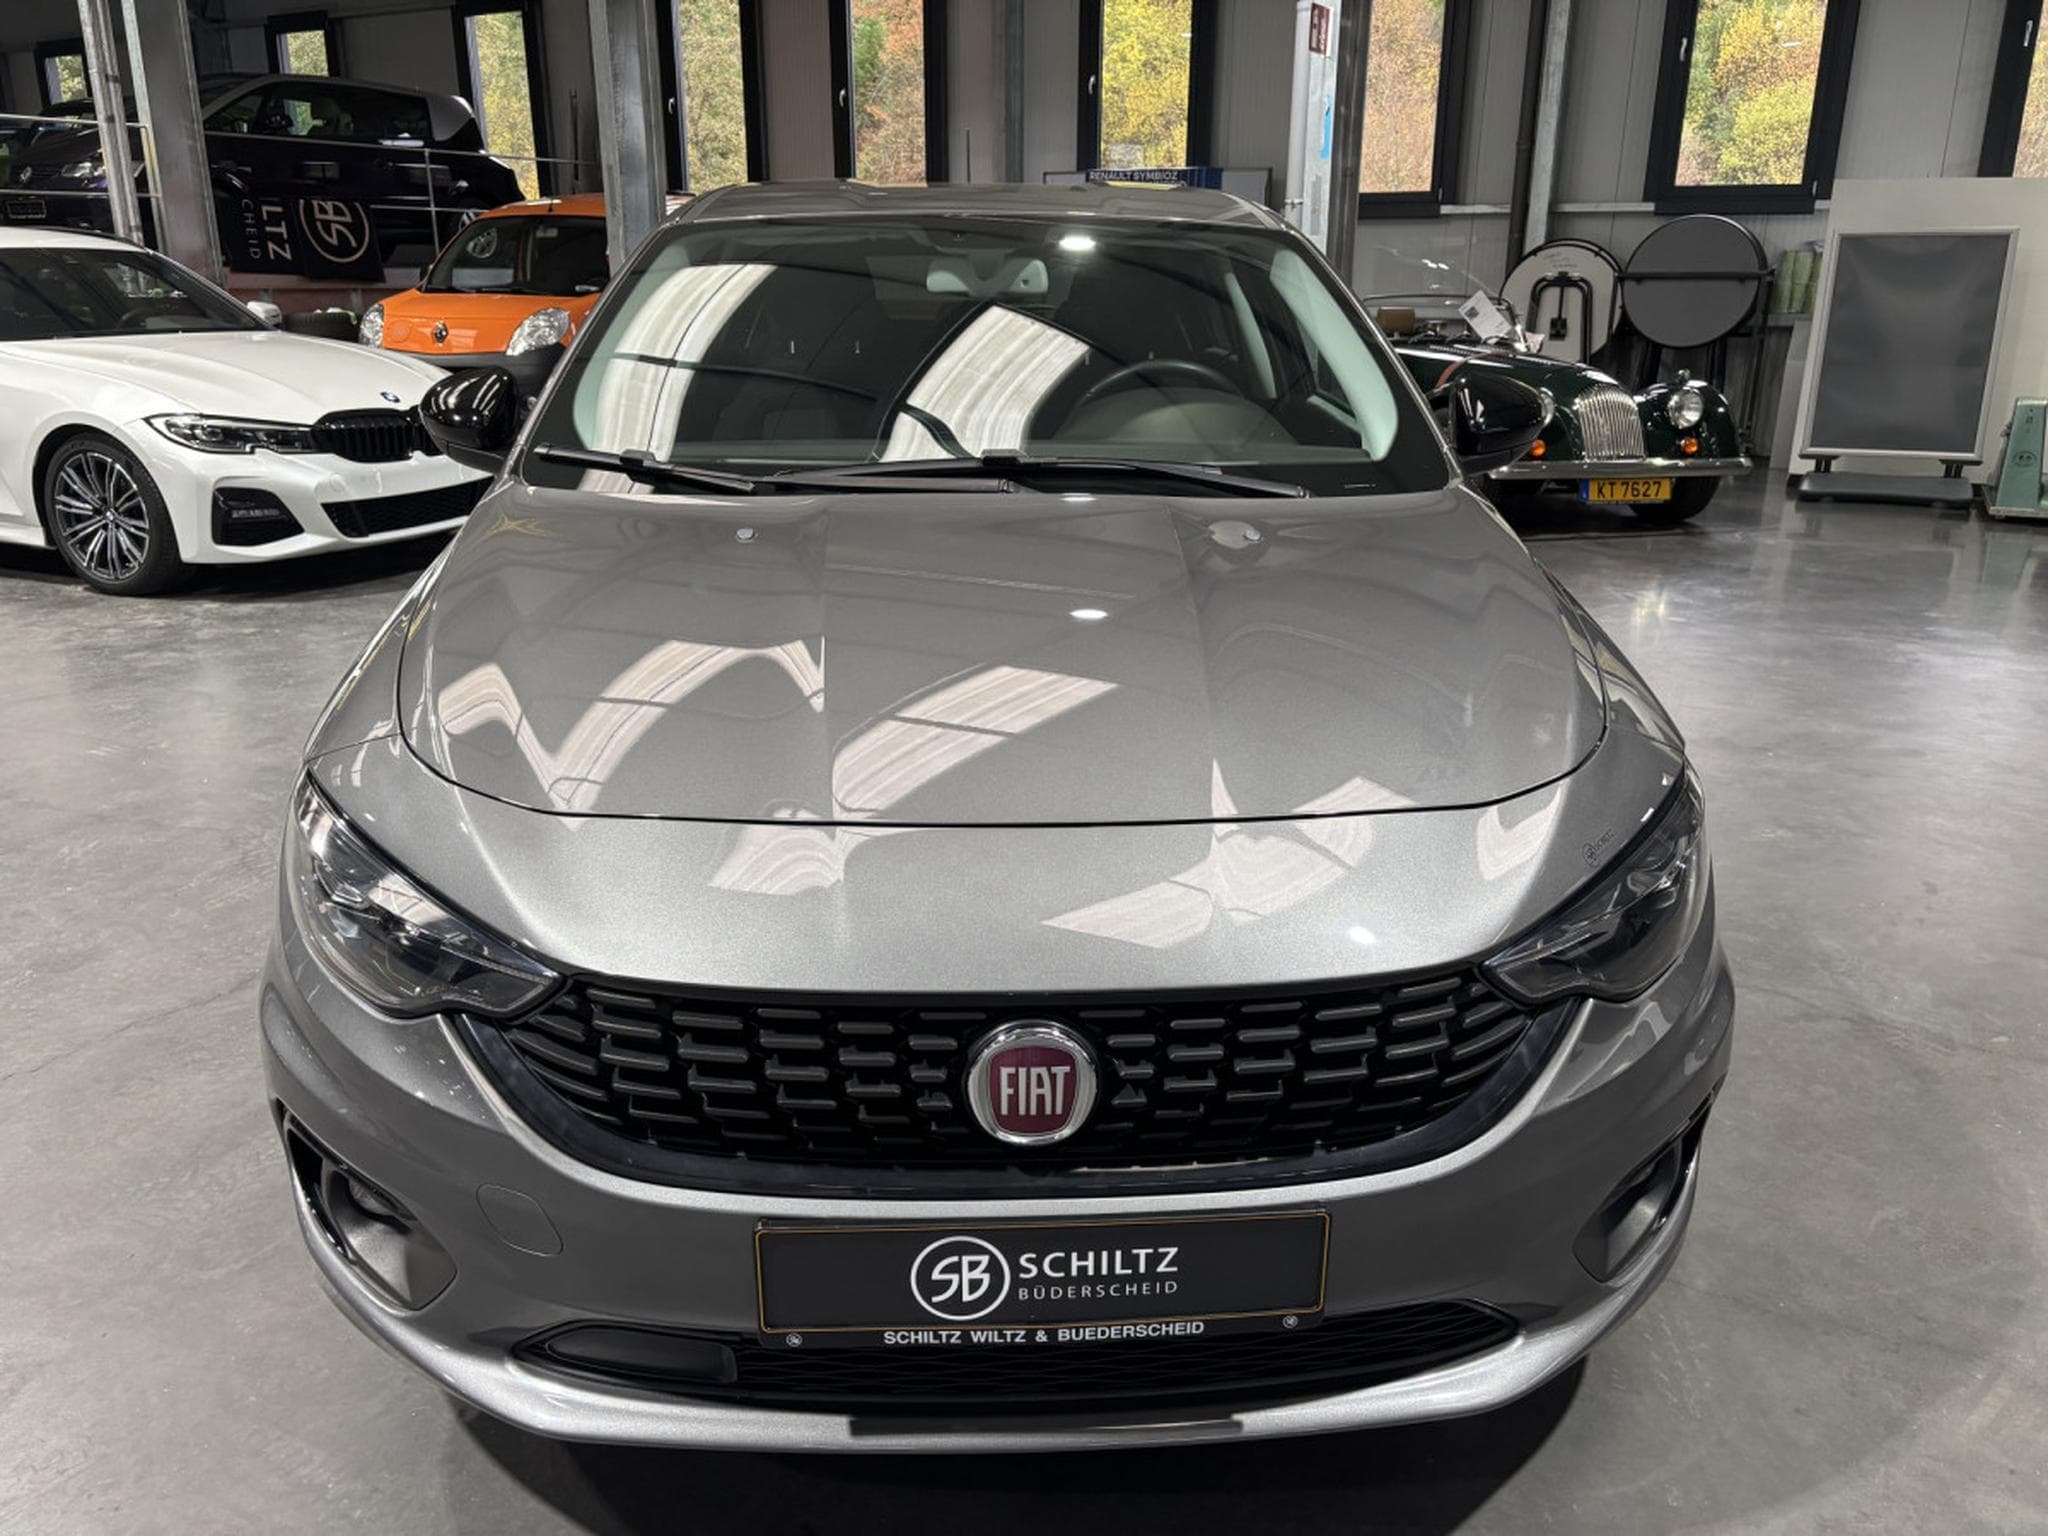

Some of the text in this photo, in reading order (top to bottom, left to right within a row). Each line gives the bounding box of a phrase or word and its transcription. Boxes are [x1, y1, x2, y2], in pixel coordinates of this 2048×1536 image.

[1089, 170, 1178, 181] RENAULT SYMBIOZ
[1000, 1066, 1071, 1116] FIAT
[1018, 1246, 1179, 1279] SCHILTZ
[931, 1255, 990, 1303] SB
[1018, 1281, 1178, 1300] BÜDERSCHEID
[883, 1321, 1204, 1345] SCHILTZ WILTZ & BUEDERSCHEID
